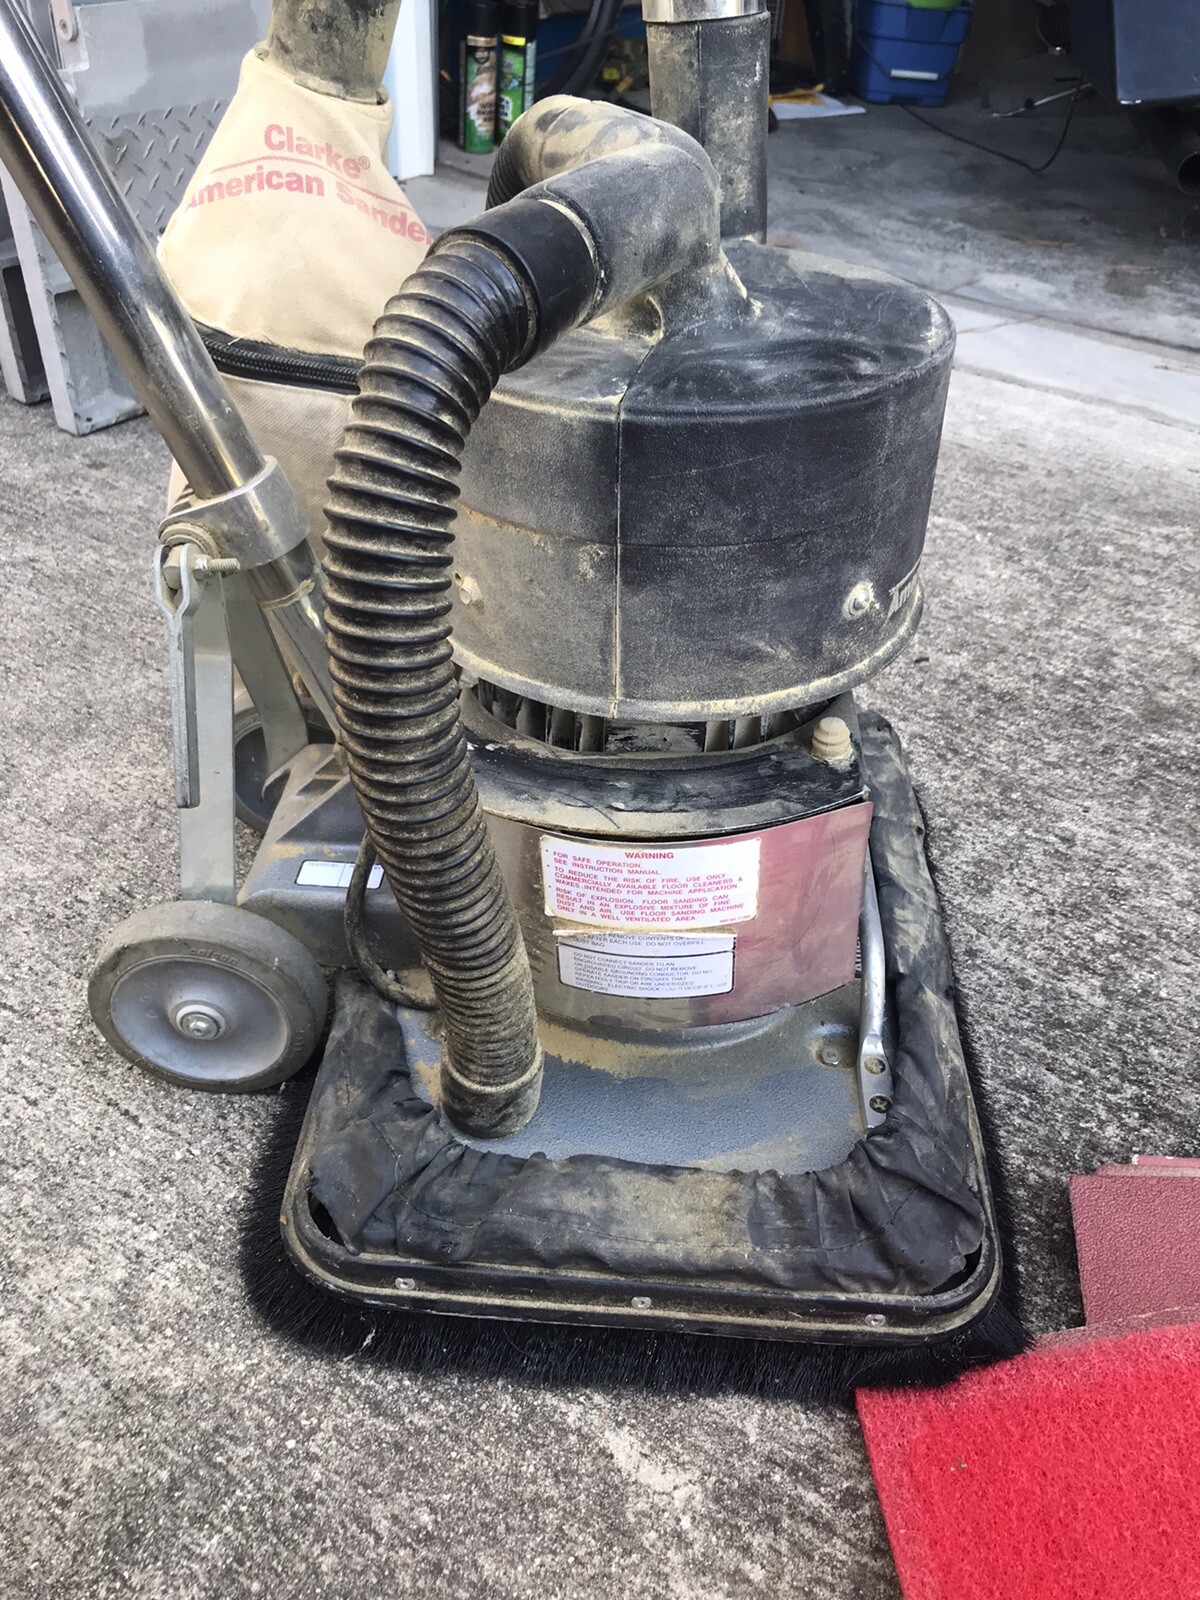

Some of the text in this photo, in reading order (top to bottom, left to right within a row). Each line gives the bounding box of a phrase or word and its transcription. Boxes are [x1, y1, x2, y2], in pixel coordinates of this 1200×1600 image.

[553, 851, 568, 859] FOR
[572, 856, 592, 864] SAFE
[572, 862, 622, 874] INSTRUCTION
[554, 872, 612, 887] COMMERCIALLY
[692, 878, 734, 888] CLEANERS
[568, 870, 598, 880] REDUCE
[554, 878, 580, 888] WAXES
[584, 885, 622, 894] INTENDED
[556, 893, 582, 903] RESULT
[556, 899, 574, 907] DUST
[710, 903, 744, 913] MACHINE
[557, 904, 575, 913] ONLY
